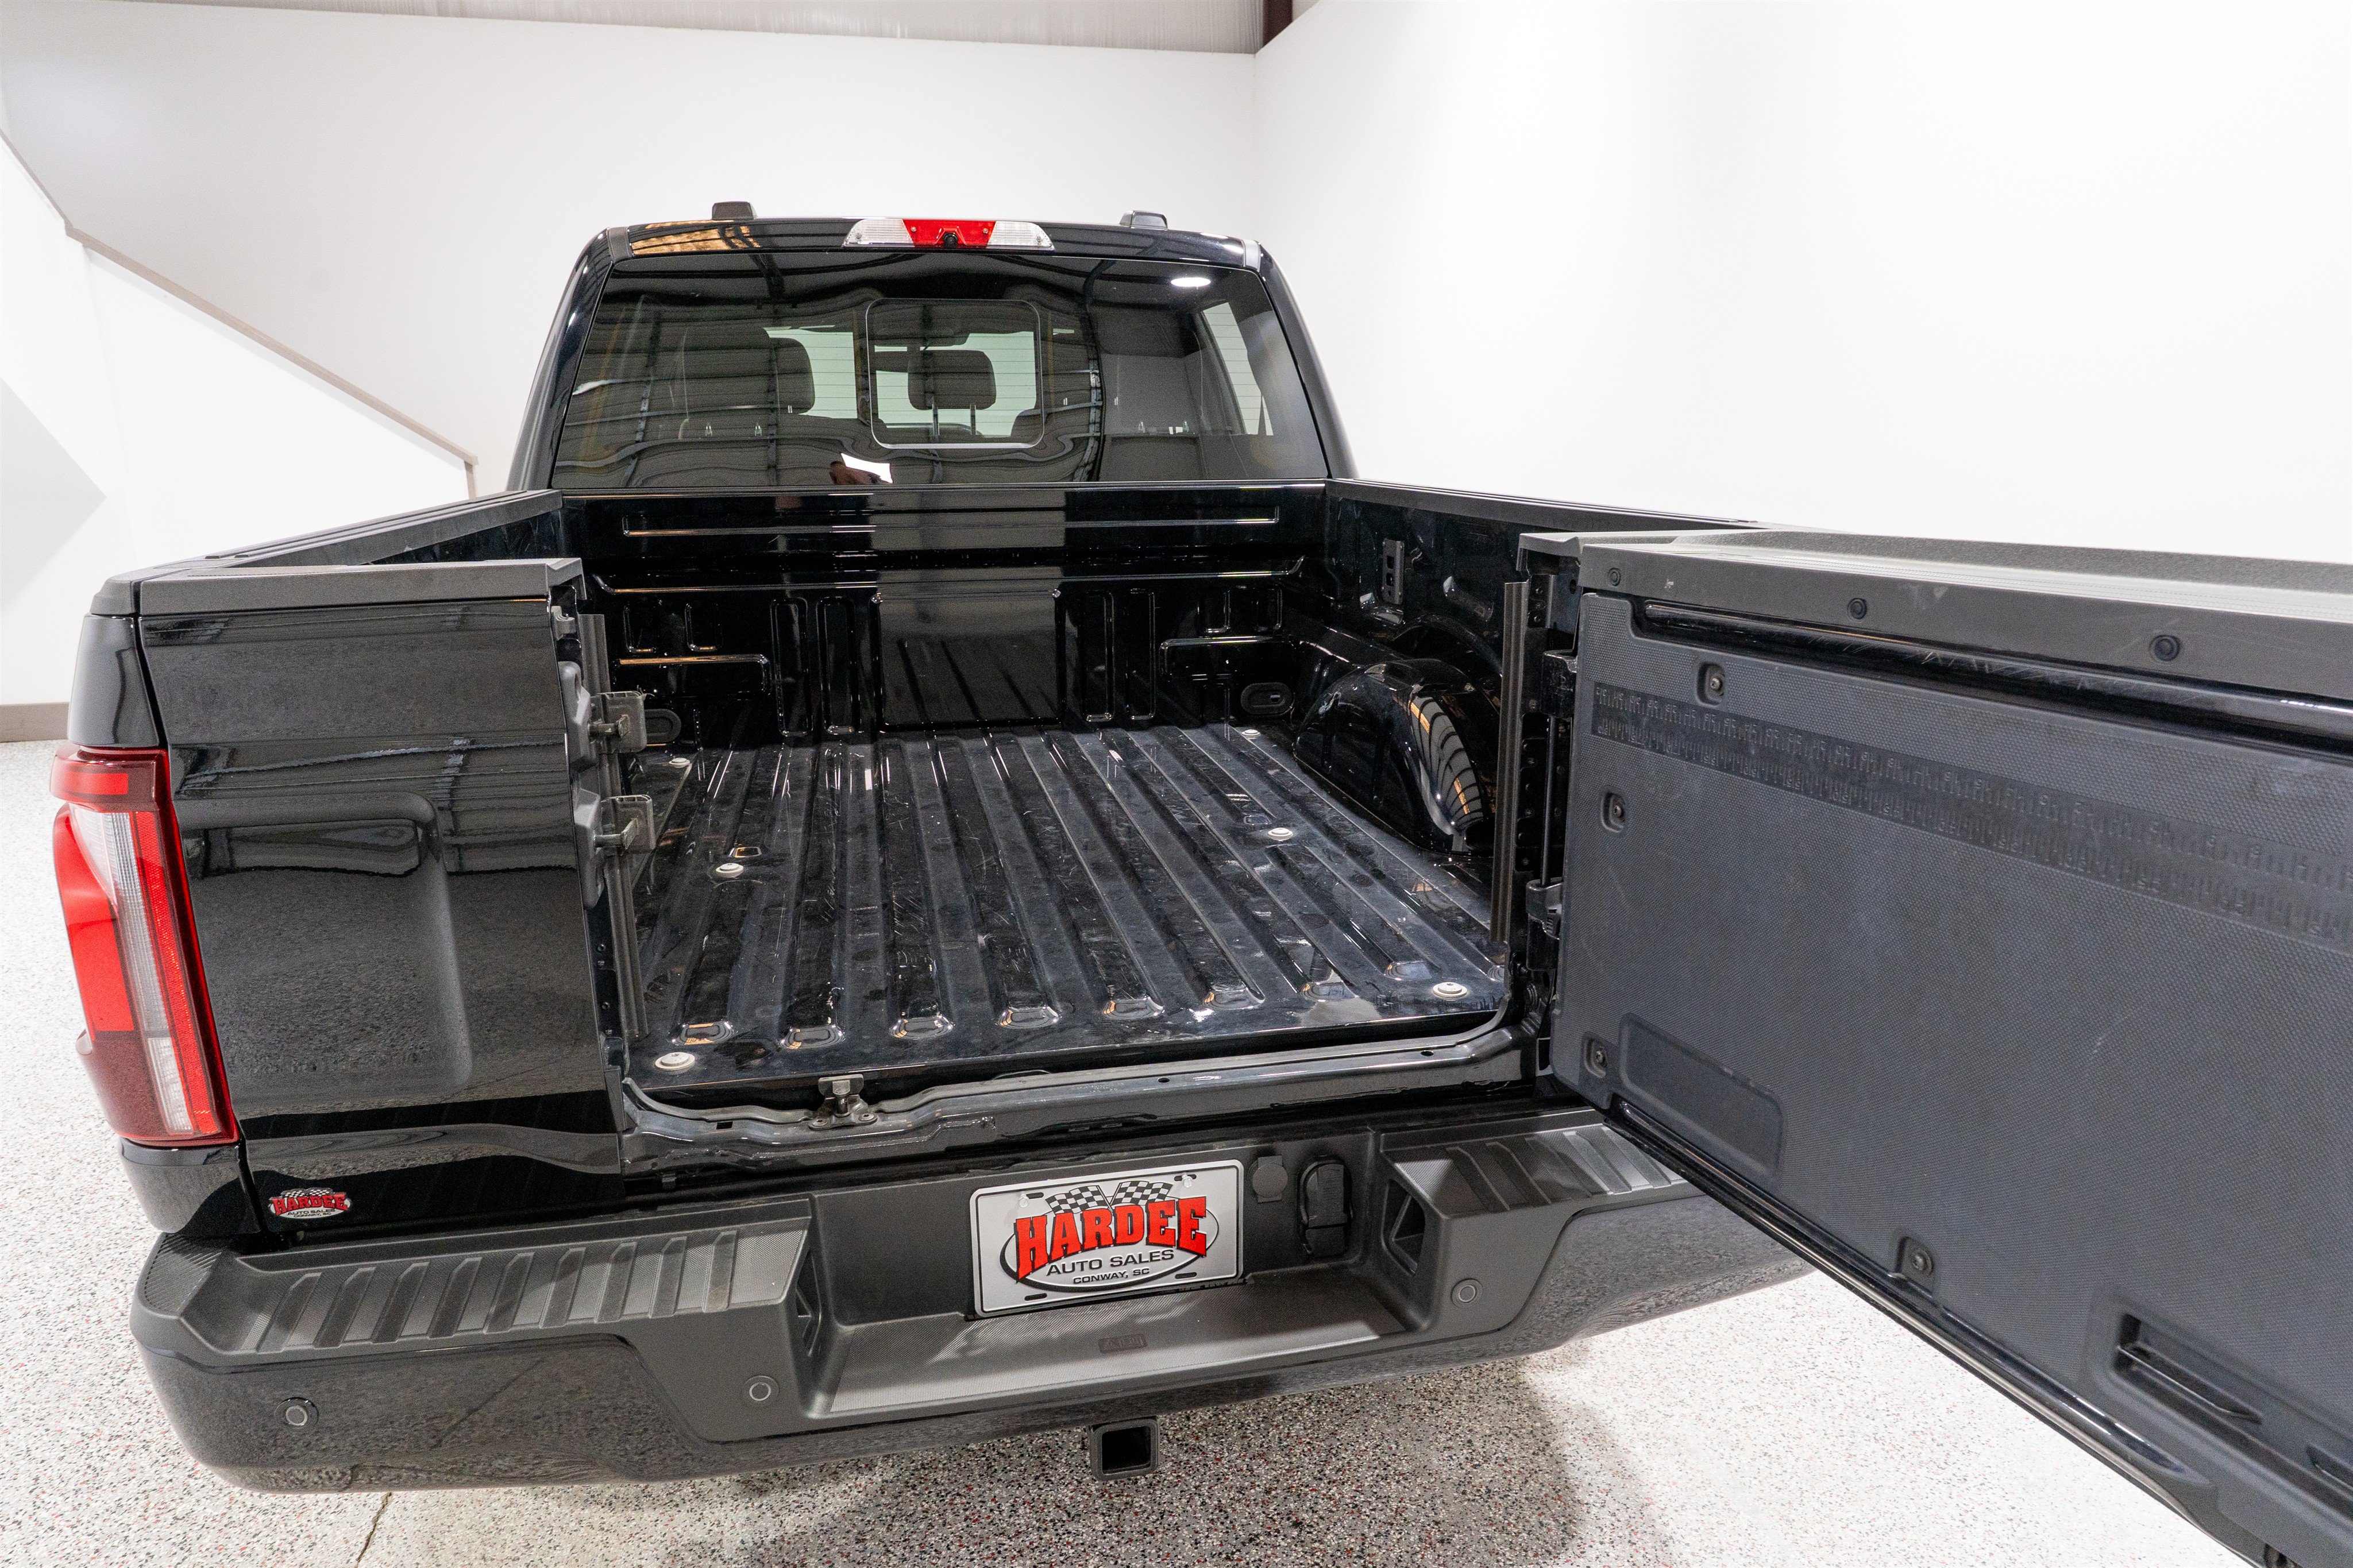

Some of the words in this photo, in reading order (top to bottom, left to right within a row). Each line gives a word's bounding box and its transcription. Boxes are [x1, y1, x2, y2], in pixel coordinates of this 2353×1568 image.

[271, 1192, 349, 1216] HARDEE
[1014, 1196, 1207, 1283] HARDEE
[1046, 1258, 1103, 1277] AUTO
[1109, 1249, 1175, 1268] SALES
[1073, 1270, 1129, 1285] CONWAY,
[1132, 1267, 1150, 1276] SC
